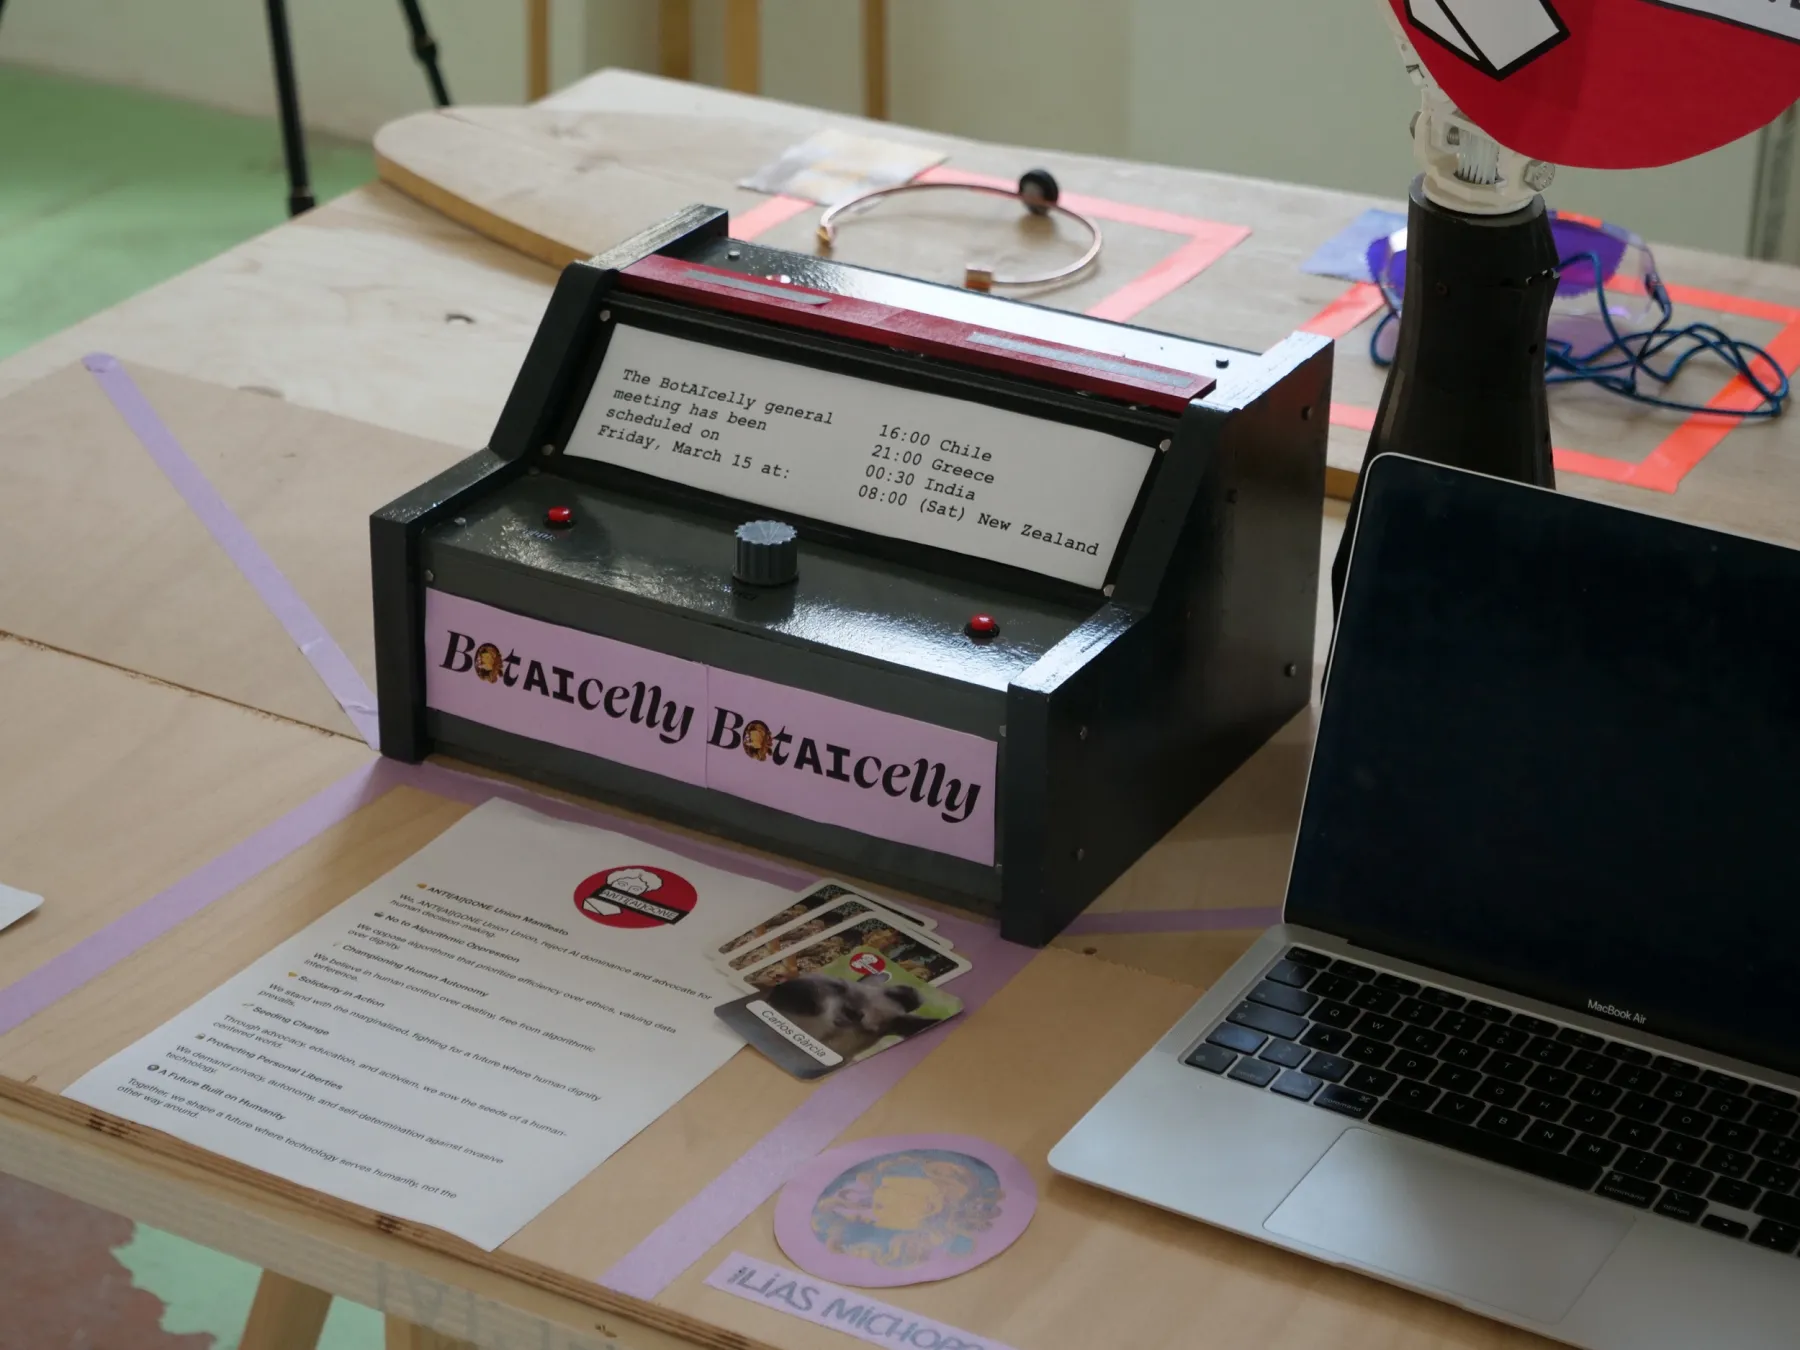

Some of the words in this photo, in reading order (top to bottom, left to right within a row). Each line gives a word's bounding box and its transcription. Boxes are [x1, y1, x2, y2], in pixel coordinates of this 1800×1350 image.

[613, 388, 681, 415] meeting
[689, 405, 718, 420] has
[726, 412, 767, 431] been
[622, 368, 650, 385] The
[659, 377, 756, 410] BotAIcelly
[764, 401, 833, 425] general
[606, 407, 692, 435] scheduled
[700, 428, 720, 441] on
[879, 424, 930, 447] 16:00
[940, 439, 992, 462] Chile
[598, 424, 660, 450] Friday,
[672, 441, 722, 462] March
[732, 455, 752, 469] 15
[761, 464, 790, 479] at:
[872, 444, 922, 466] 21:00
[932, 458, 995, 484] Greece
[866, 464, 915, 486] 00:30
[924, 478, 976, 501] India
[858, 484, 907, 506] 08:00
[920, 498, 966, 522] (Sat)
[978, 512, 1011, 532] New
[1020, 524, 1100, 556] Zealand
[347, 929, 369, 939] over
[384, 915, 400, 923] No
[411, 924, 465, 945] Algorithmic
[466, 941, 520, 963] Oppression
[390, 899, 422, 913] human
[421, 910, 495, 938] decision-making.
[493, 907, 522, 920] Union
[522, 916, 569, 936] Manifesto
[399, 893, 415, 904] We,
[481, 921, 510, 934] Union
[510, 929, 538, 944] Union,
[540, 941, 569, 953] reject
[580, 954, 632, 974] dominance
[632, 971, 653, 981] and
[652, 978, 697, 996] advocate
[697, 992, 713, 1000] for
[298, 975, 343, 994] Solidarity
[353, 994, 385, 1008] Action
[304, 959, 358, 981] interference.
[342, 944, 404, 969] Championing
[404, 965, 439, 981] Human
[439, 977, 489, 998] Autonomy
[356, 923, 372, 932] We
[372, 929, 407, 943] oppose
[407, 941, 456, 959] algorithms
[456, 956, 476, 966] that
[474, 963, 517, 980] prioritize
[517, 977, 563, 996] efficiency
[563, 992, 585, 1003] over
[619, 1011, 653, 1027] valuing
[654, 1023, 677, 1034] data
[252, 1006, 292, 1024] Seeding
[292, 1020, 330, 1036] Change
[313, 952, 329, 962] We
[328, 958, 363, 973] believe
[362, 969, 373, 977] in
[372, 972, 405, 987] human
[405, 984, 440, 999] control
[439, 996, 461, 1006] over
[498, 1015, 518, 1026] free
[518, 1022, 541, 1034] from
[542, 1031, 596, 1053] algorithmic
[762, 1010, 793, 1035] Carlos
[1588, 999, 1632, 1020] MacBook
[1632, 1012, 1646, 1024] Air
[213, 1022, 256, 1039] centered
[254, 1035, 283, 1049] world.
[269, 983, 284, 992] We
[284, 990, 313, 1002] stand
[312, 999, 332, 1008] with
[332, 1004, 349, 1014] the
[349, 1011, 410, 1036] marginalized,
[411, 1032, 448, 1050] fighting
[448, 1045, 463, 1054] for
[472, 1053, 501, 1067] future
[502, 1064, 532, 1078] where
[532, 1074, 566, 1090] human
[567, 1087, 601, 1102] dignity
[206, 1037, 256, 1059] Protecting
[256, 1054, 301, 1074] Personal
[300, 1070, 343, 1090] Liberties
[224, 1014, 261, 1031] Through
[308, 1045, 356, 1066] education,
[358, 1063, 380, 1073] and
[378, 1070, 419, 1089] activism,
[422, 1085, 438, 1094] we
[438, 1091, 460, 1101] sow
[460, 1097, 477, 1107] the
[477, 1104, 508, 1118] seeds
[116, 1086, 144, 1098] other
[143, 1095, 164, 1106] way
[163, 1102, 200, 1118] around.
[167, 1071, 200, 1087] Future
[200, 1083, 225, 1096] Built
[224, 1093, 238, 1102] on
[238, 1098, 286, 1121] Humanity
[176, 1045, 192, 1054] We
[192, 1052, 232, 1069] demand
[317, 1098, 340, 1109] and
[338, 1106, 425, 1139] self-determination
[425, 1136, 463, 1151] against
[463, 1147, 504, 1164] invasive
[170, 1094, 186, 1103] we
[185, 1100, 216, 1115] shape
[224, 1114, 253, 1129] future
[254, 1126, 284, 1141] where
[284, 1137, 339, 1162] technology
[338, 1159, 372, 1173] serves
[372, 1168, 419, 1188] humanity,
[421, 1184, 440, 1194] not
[439, 1189, 457, 1199] the
